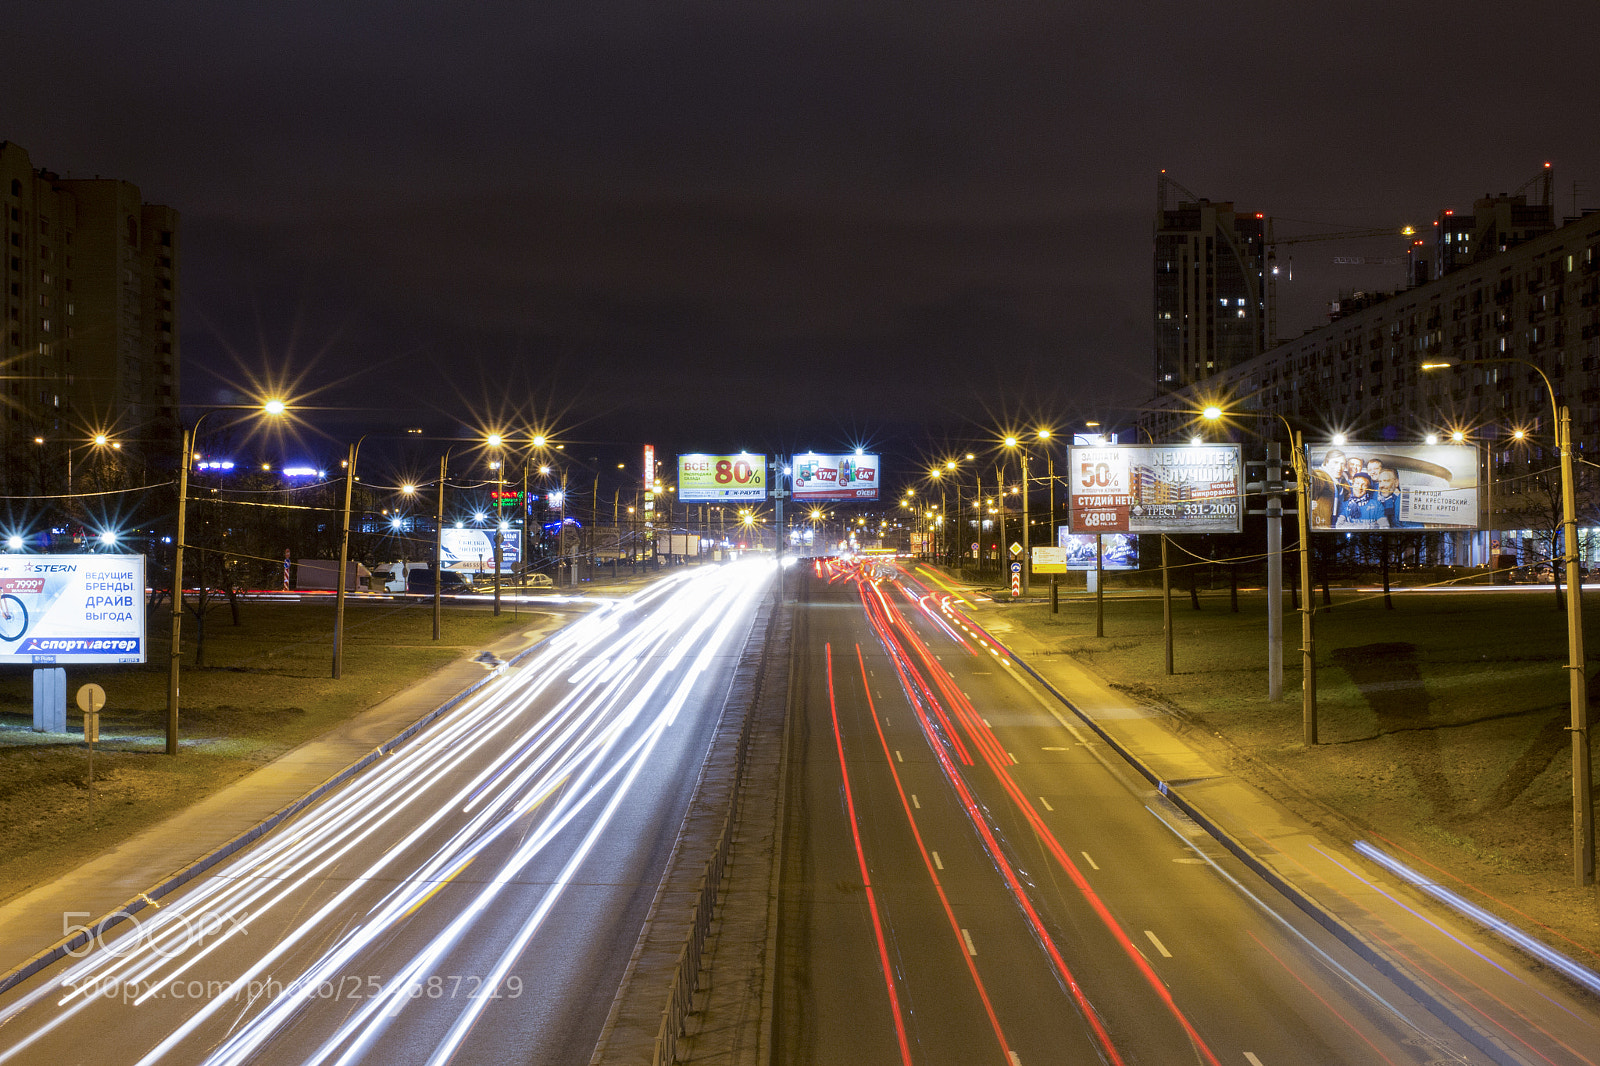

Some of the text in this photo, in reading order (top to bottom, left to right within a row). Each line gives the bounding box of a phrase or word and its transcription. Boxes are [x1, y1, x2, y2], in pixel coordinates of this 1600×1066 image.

[684, 462, 709, 471] ВСЕ!
[714, 459, 761, 484] 80%
[1081, 462, 1119, 487] 50%
[1168, 465, 1234, 482] ЛУЧШИЙ
[1191, 488, 1236, 498] микрорайон
[1414, 489, 1442, 498] ПРИХОДИ
[1078, 494, 1113, 507] СТУДИЙ
[1147, 507, 1177, 516] ТРЕСТ
[1183, 503, 1237, 515] 331-2000
[1436, 504, 1459, 512] КРУТО!
[1315, 516, 1326, 524] 0+
[34, 564, 77, 573] STERN
[85, 572, 133, 580] ВЕДУЩИЕ
[85, 612, 133, 622] ВЫГОДА
